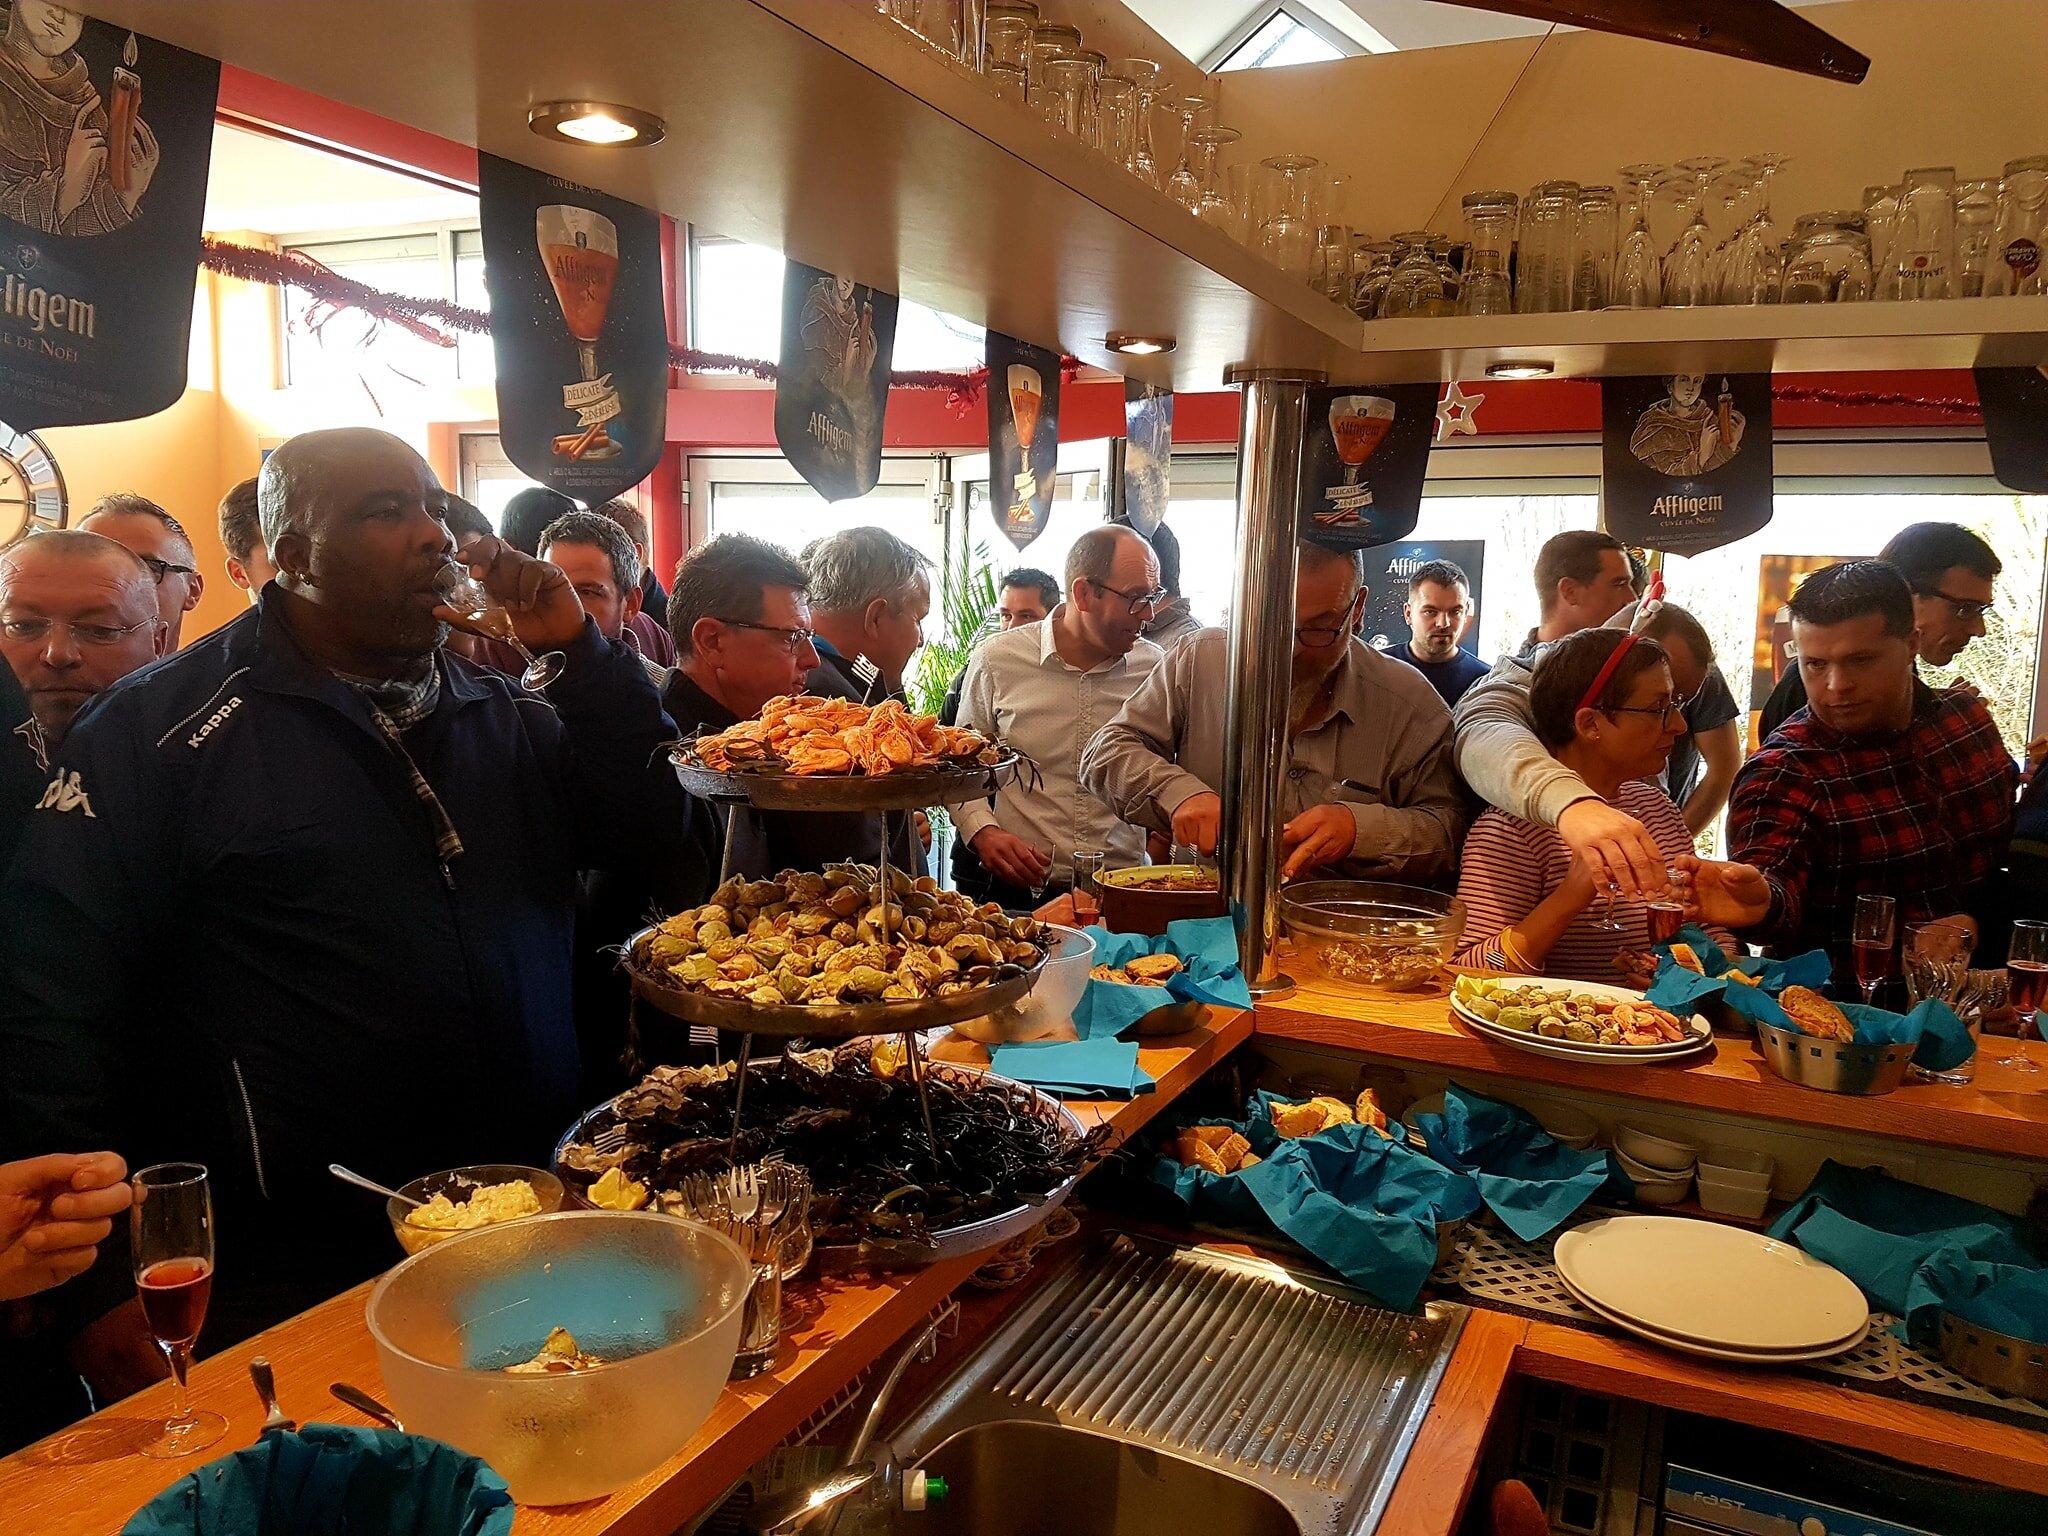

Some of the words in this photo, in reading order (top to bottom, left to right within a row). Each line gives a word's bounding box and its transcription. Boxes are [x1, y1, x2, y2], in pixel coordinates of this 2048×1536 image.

[1898, 267, 1945, 280] JAMESON
[0, 266, 95, 339] ligem
[806, 411, 852, 453] Affligem
[1650, 494, 1722, 518] Affligem
[1386, 558, 1432, 577] Affli
[187, 696, 243, 749] Kappa
